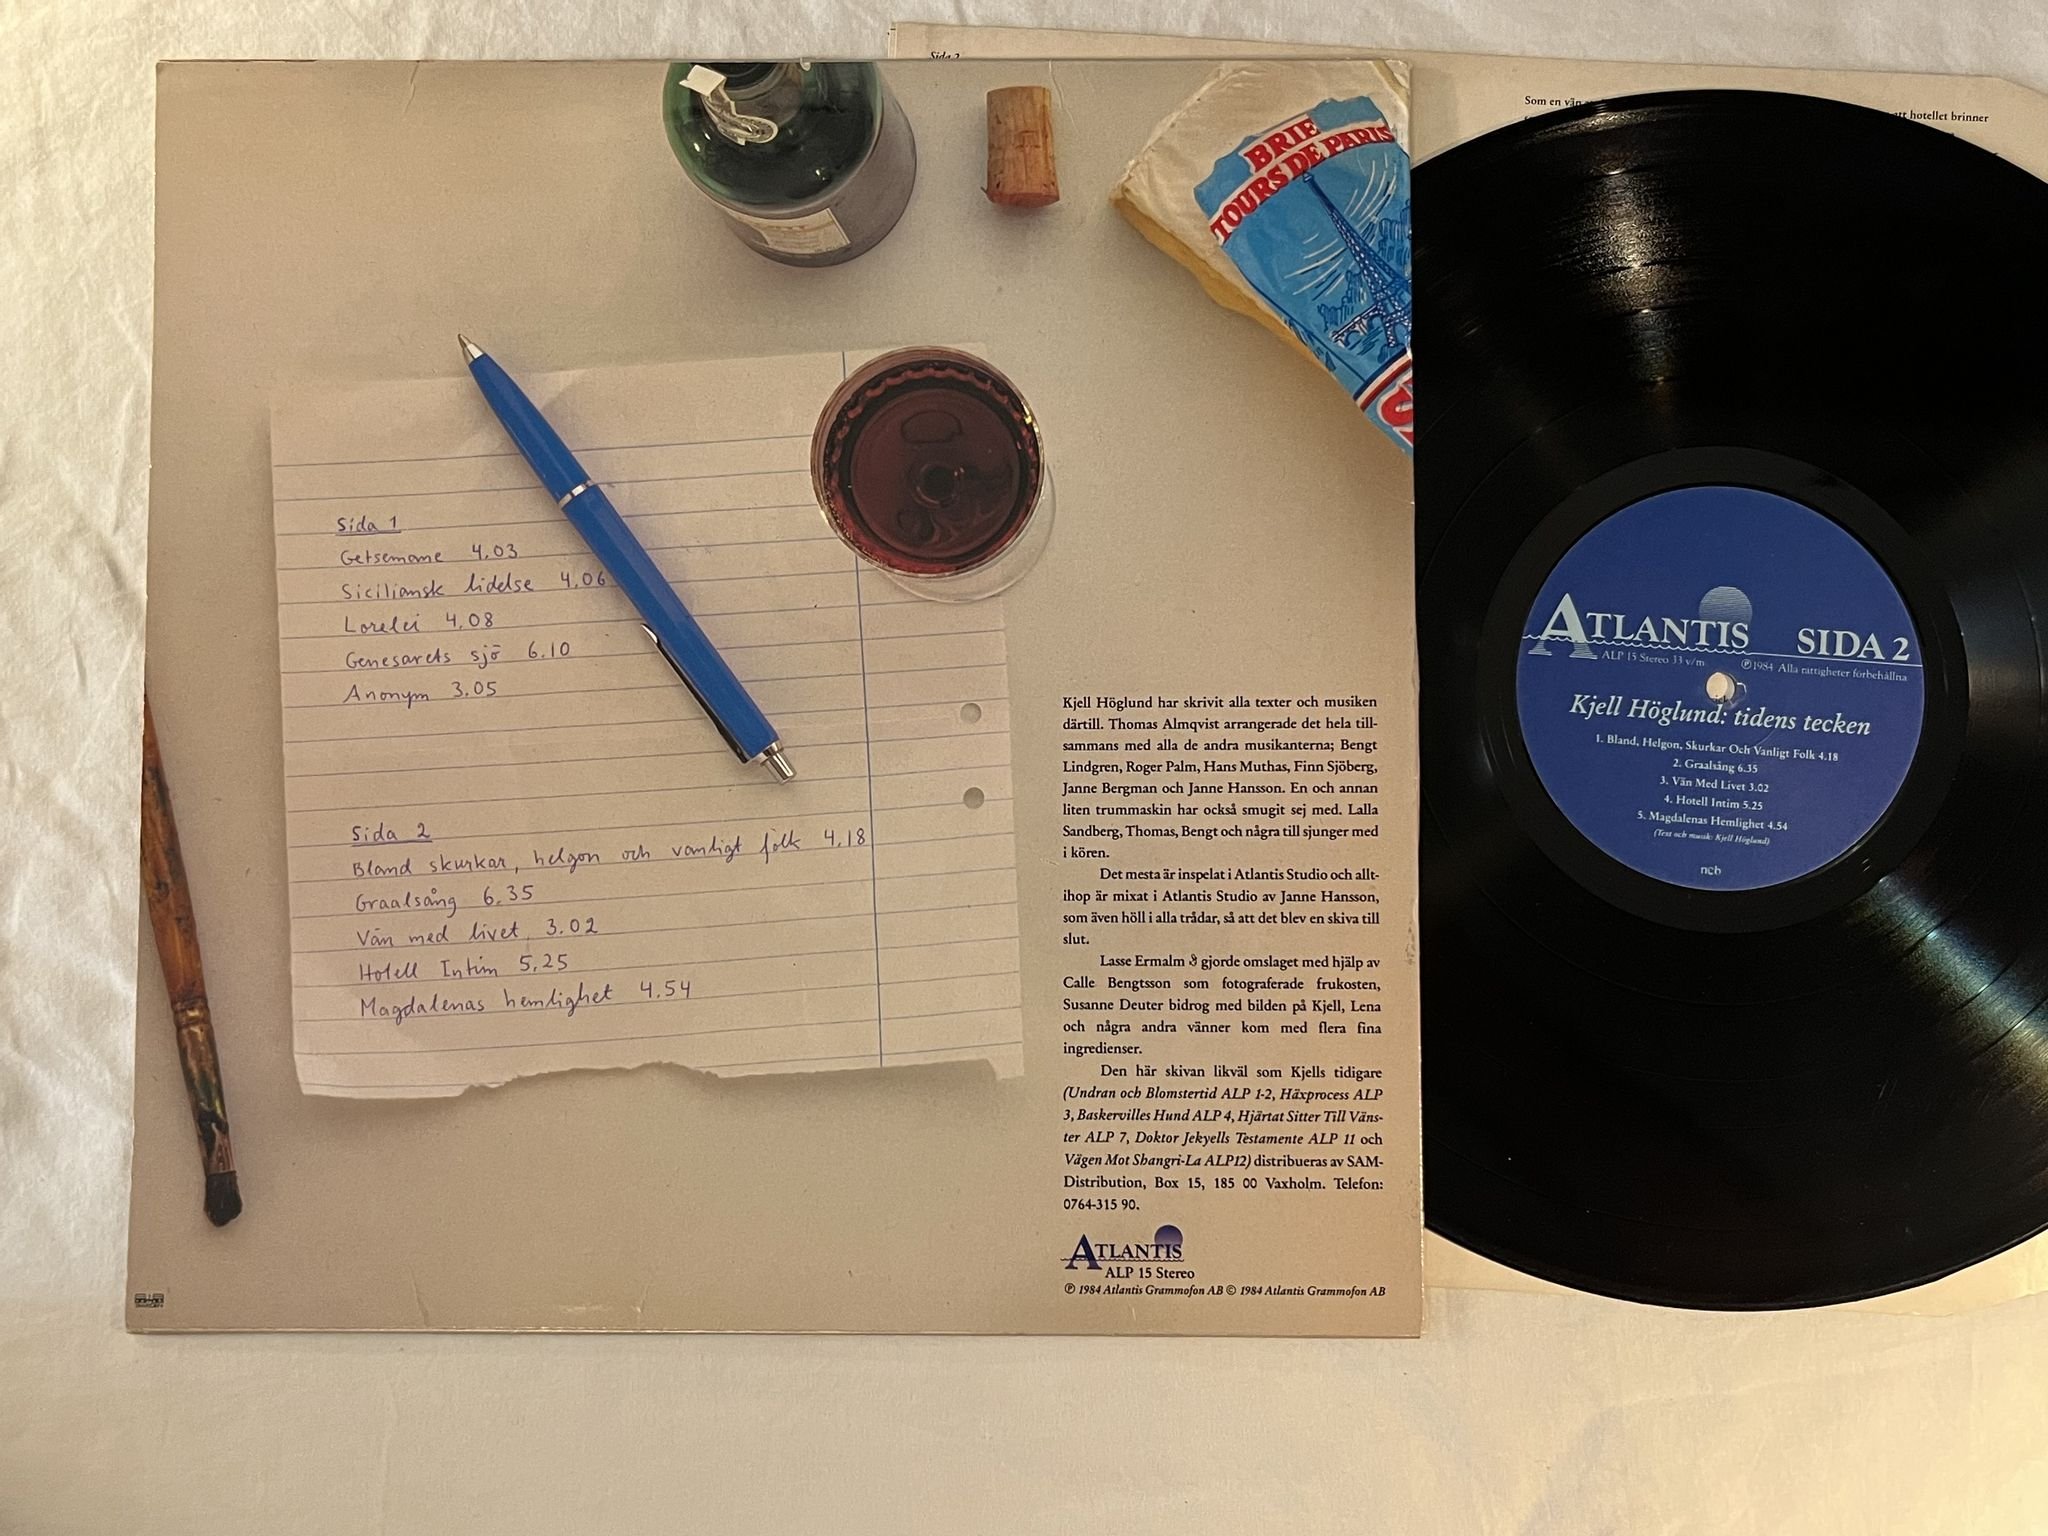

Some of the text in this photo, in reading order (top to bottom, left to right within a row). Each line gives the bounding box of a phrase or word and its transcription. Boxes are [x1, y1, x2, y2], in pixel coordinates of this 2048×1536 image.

[1525, 95, 1546, 105] Som
[1910, 109, 1947, 120] hotellet
[1951, 111, 1989, 122] brinner
[1243, 118, 1321, 173] BRIE
[1210, 126, 1395, 246] TOURS DE PARIS
[337, 515, 396, 533] Sida 1
[341, 550, 445, 566] Getsemane
[342, 580, 445, 599] Siciliansk
[464, 572, 534, 593] lidelse
[344, 613, 420, 634] Lorelei
[1528, 592, 1911, 662] ATLANTIS SIDA 2
[346, 648, 452, 668] Genesarets
[1602, 650, 1624, 661] ALP
[1627, 651, 1637, 661] 15
[1639, 653, 1669, 664] Stereo
[1778, 663, 1799, 673] Alla
[343, 684, 430, 709] Anonym
[1063, 695, 1377, 711] Kjell Höglund har skrivit alla texter och musiken
[1569, 694, 1871, 735] Kjell Höglund: tidens tecken
[1596, 733, 1839, 762] 1. Bland, Helgon, Skurkar Och Vanligt Folk 4.18
[1063, 760, 1378, 776] Lindgren, Roger Palm, Hans Muthas, Finn Sjöberg,
[1672, 758, 1682, 768] 2.
[1737, 763, 1758, 774] 6.35
[1659, 776, 1669, 786] 3.
[1695, 778, 1718, 789] Med
[1721, 780, 1746, 791] Livet
[1748, 783, 1769, 793] 3.02
[1664, 795, 1763, 811] 4. Hotell Intim 5.25
[1636, 810, 1788, 831] 5. Magdalenas Hemlighet 4.54
[352, 822, 431, 842] Sida 2
[353, 858, 412, 877] Bland
[533, 847, 600, 874] helgon
[622, 844, 651, 861] och
[760, 828, 801, 864] folk
[1100, 868, 1379, 883] Det mesta är inspelat i Atlantis Studio och allt-
[356, 887, 457, 918] Graalsång
[409, 925, 449, 944] med
[469, 921, 519, 942] livet
[359, 962, 418, 981] Hotell
[441, 956, 498, 979] Intim
[1063, 976, 1381, 993] Calle Bengtsson som fotograferade frukosten,
[361, 993, 485, 1025] Magdalenas
[503, 982, 613, 1017] hemlighet
[1063, 1086, 1383, 1103] (Undran och Blomstertid ALP 1-2, Häxprocess ALP
[1064, 1175, 1383, 1191] Distribution, Box 15, 185 00 Vaxholm. Telefon:
[1065, 1233, 1182, 1270] ATLANTIS
[1105, 1266, 1195, 1279] ALP 15 Stereo
[1079, 1285, 1101, 1294] 1984
[1103, 1284, 1143, 1294] Atlantis
[1145, 1284, 1204, 1298] Grammofon
[1207, 1286, 1223, 1295] AB
[1240, 1286, 1262, 1295] 1984
[1264, 1285, 1304, 1295] Atlantis
[1307, 1286, 1367, 1299] Grammofon
[1369, 1287, 1386, 1296] AB
